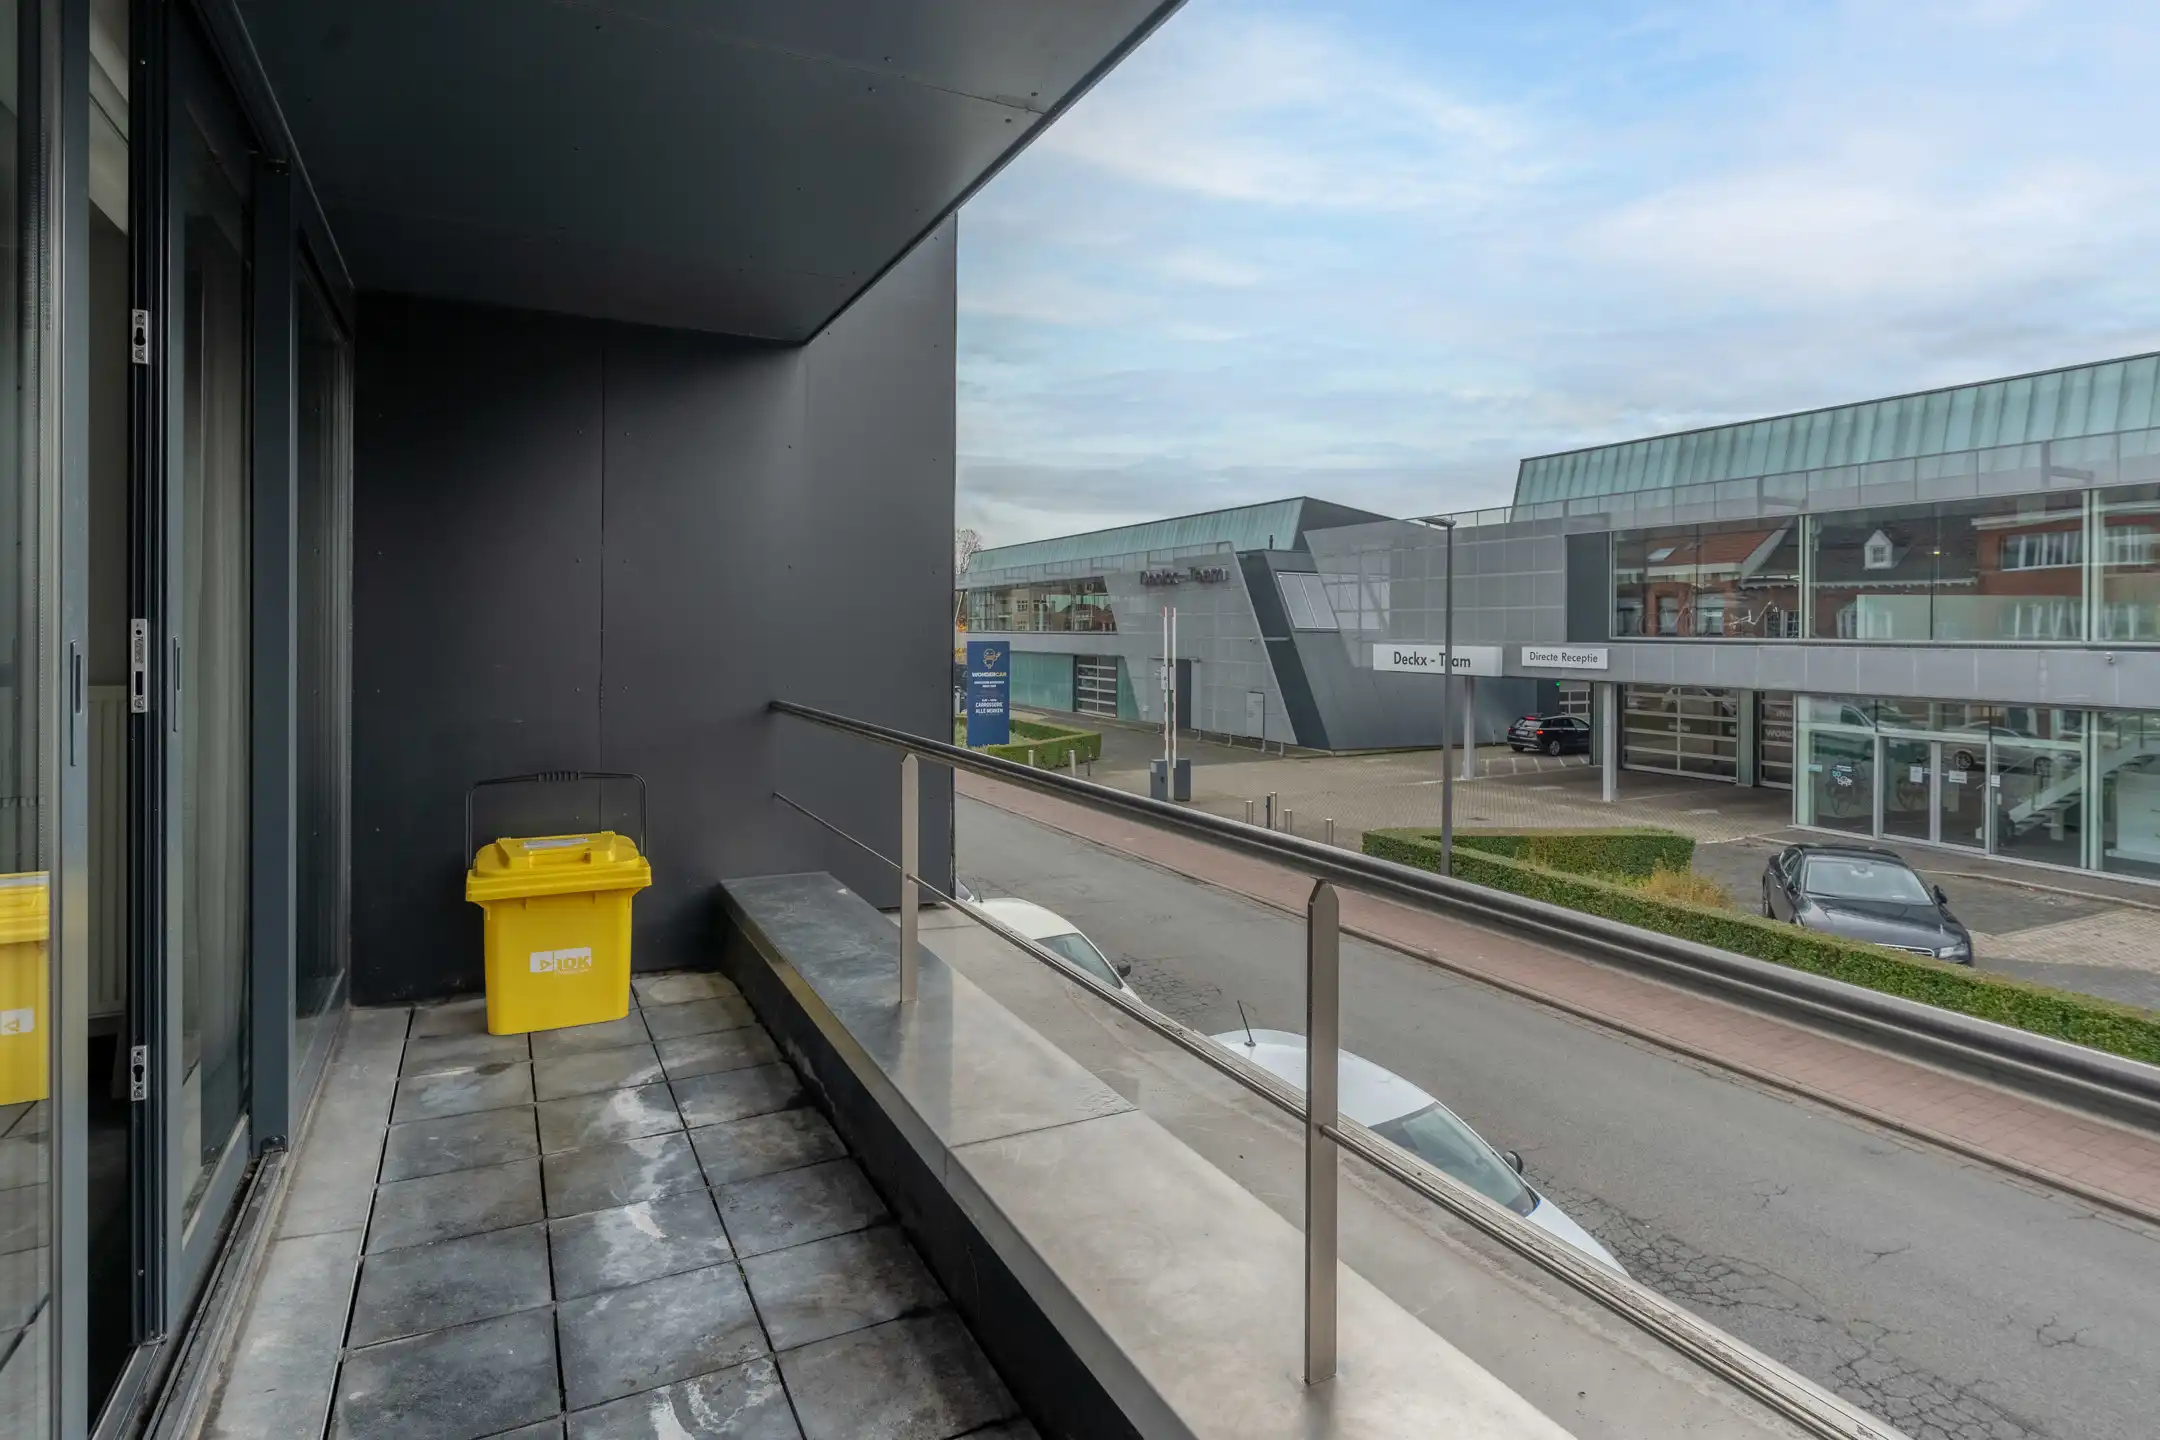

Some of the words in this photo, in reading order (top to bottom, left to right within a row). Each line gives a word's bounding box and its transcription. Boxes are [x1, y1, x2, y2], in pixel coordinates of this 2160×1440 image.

[1394, 651, 1427, 666] Deckx
[1439, 652, 1471, 668] Tam
[1529, 651, 1558, 662] Directe
[1561, 652, 1598, 664] Receptie
